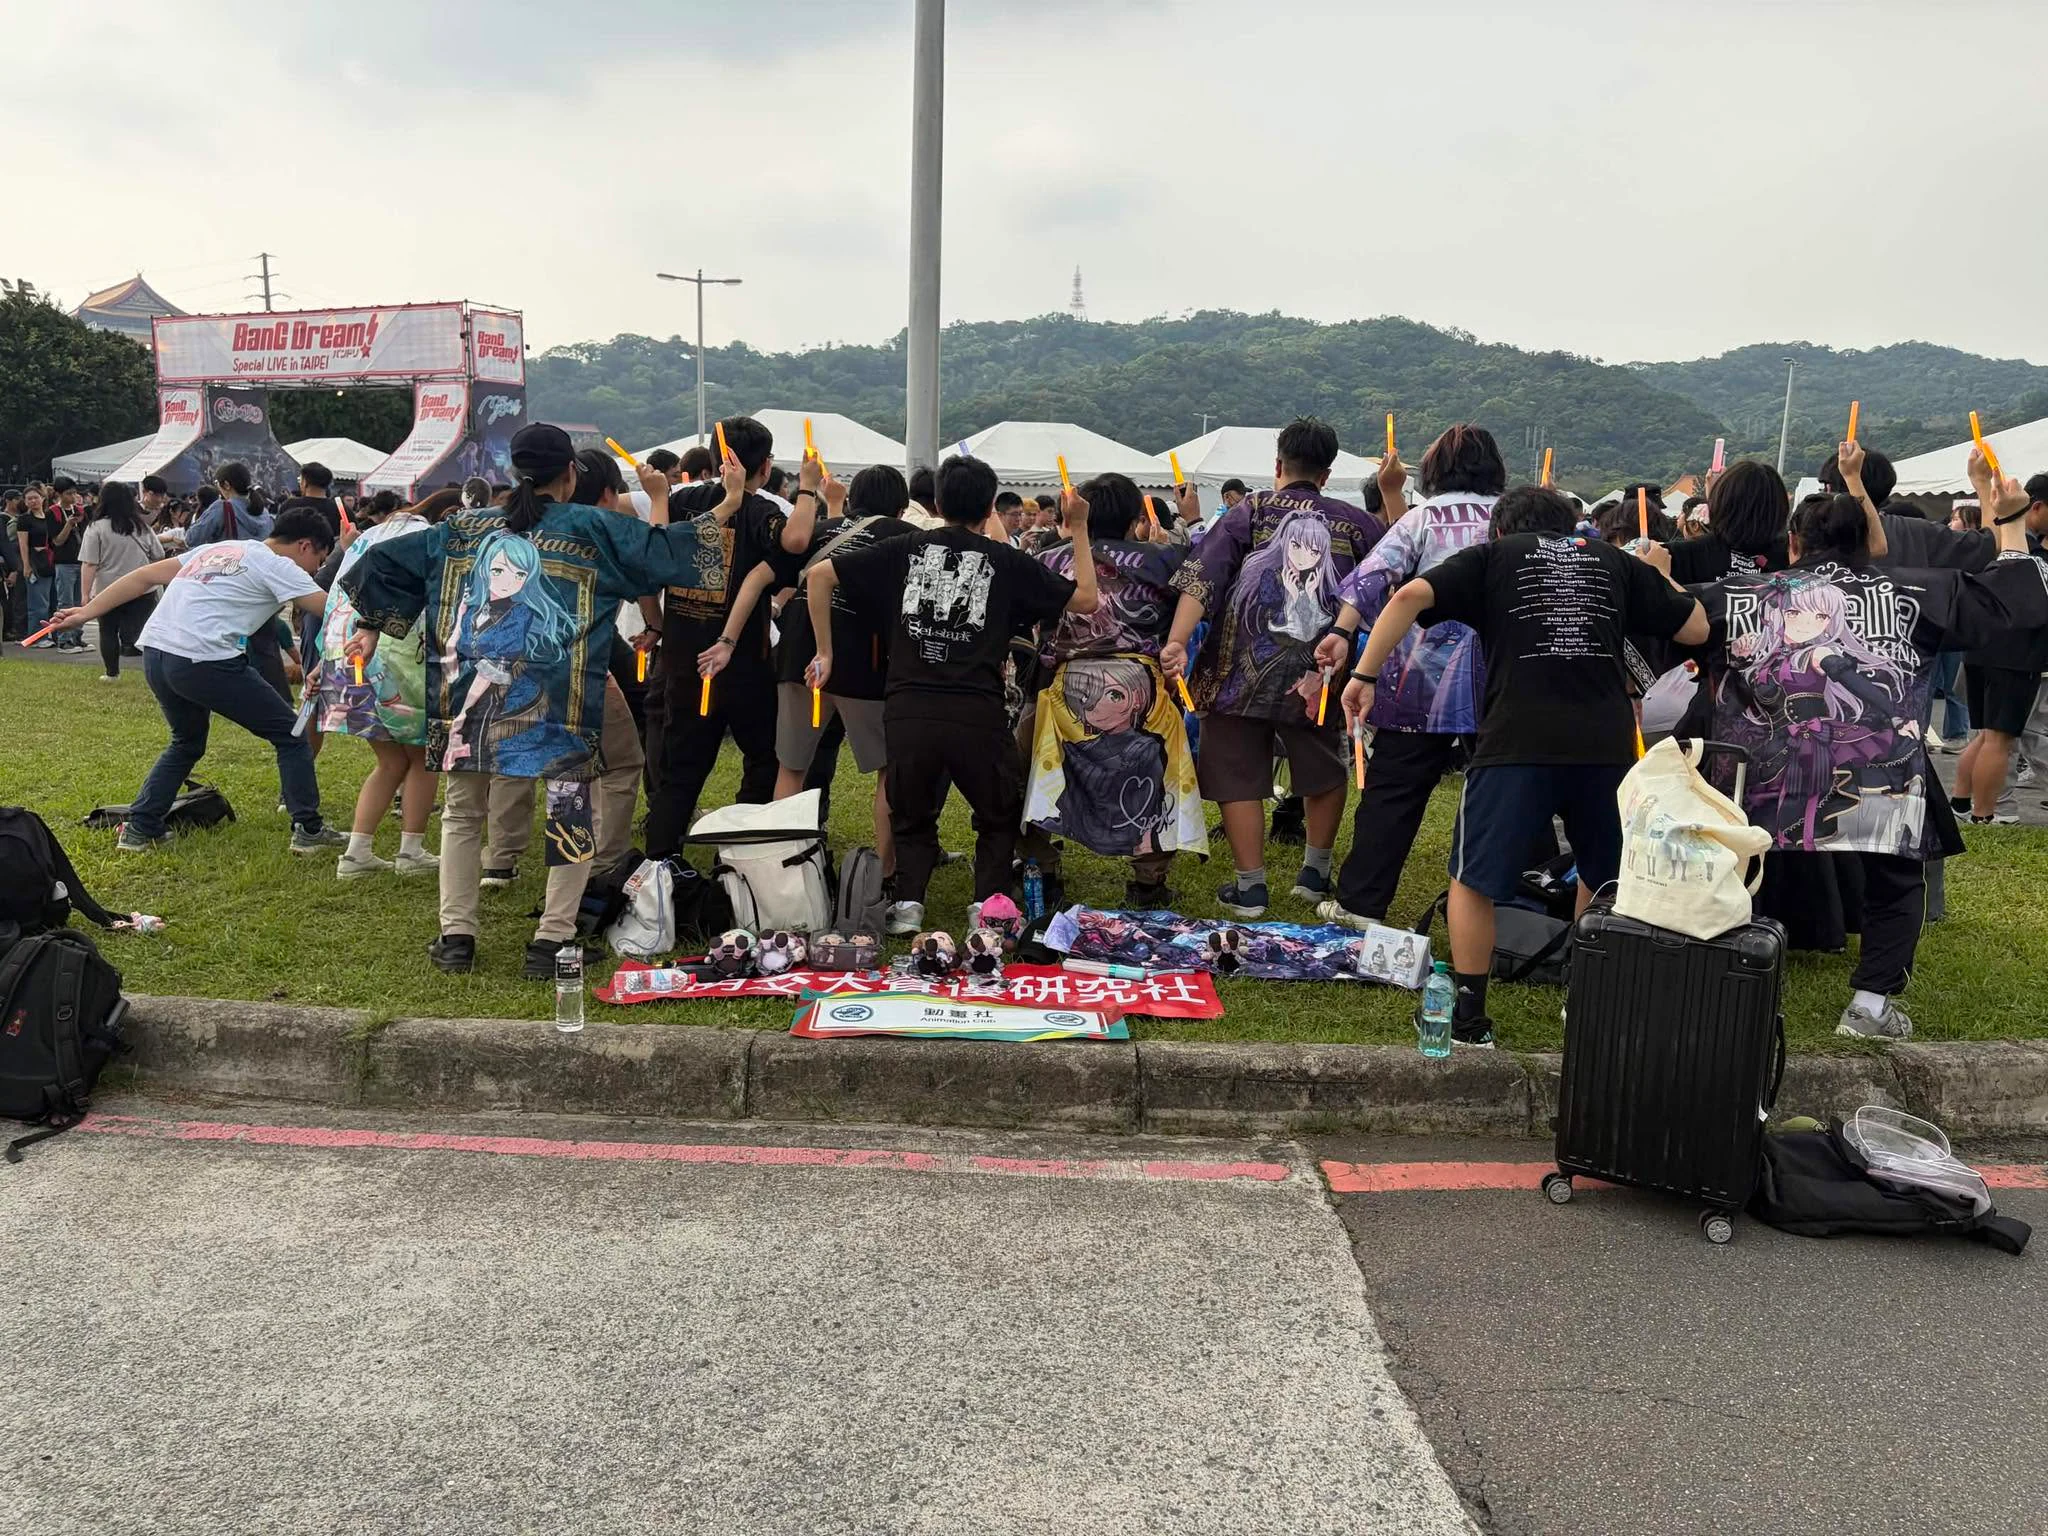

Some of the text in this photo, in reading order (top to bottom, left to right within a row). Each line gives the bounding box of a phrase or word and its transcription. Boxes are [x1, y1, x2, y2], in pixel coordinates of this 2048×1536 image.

[232, 312, 379, 358] BanG Dream!
[477, 331, 504, 346] BanG
[232, 355, 329, 373] Special LIVE in TAIPEI
[478, 345, 519, 364] Dream!
[1424, 503, 1493, 524] MIN
[531, 529, 600, 561] kawa
[1725, 581, 1920, 644] Relia
